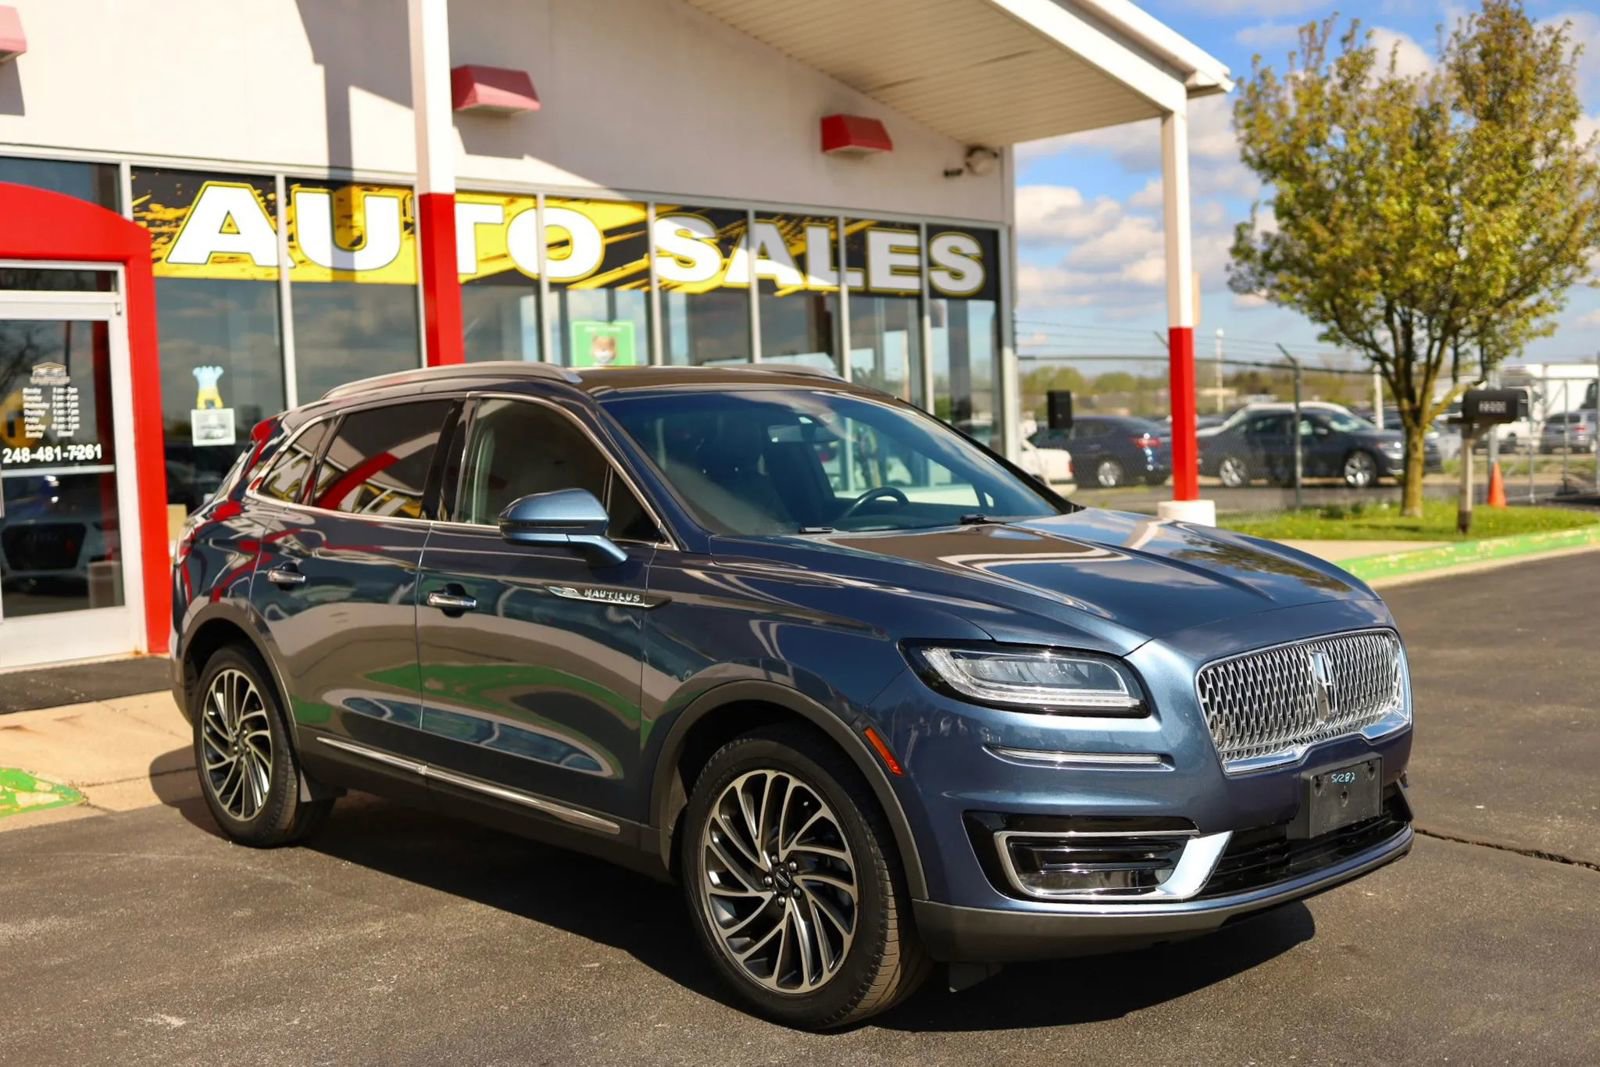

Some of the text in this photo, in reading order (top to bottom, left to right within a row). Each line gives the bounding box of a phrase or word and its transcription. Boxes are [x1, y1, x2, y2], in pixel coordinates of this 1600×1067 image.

[164, 182, 986, 296] AUTO SALES
[2, 443, 102, 464] 248-481-7261
[584, 588, 641, 602] NAUTILUS
